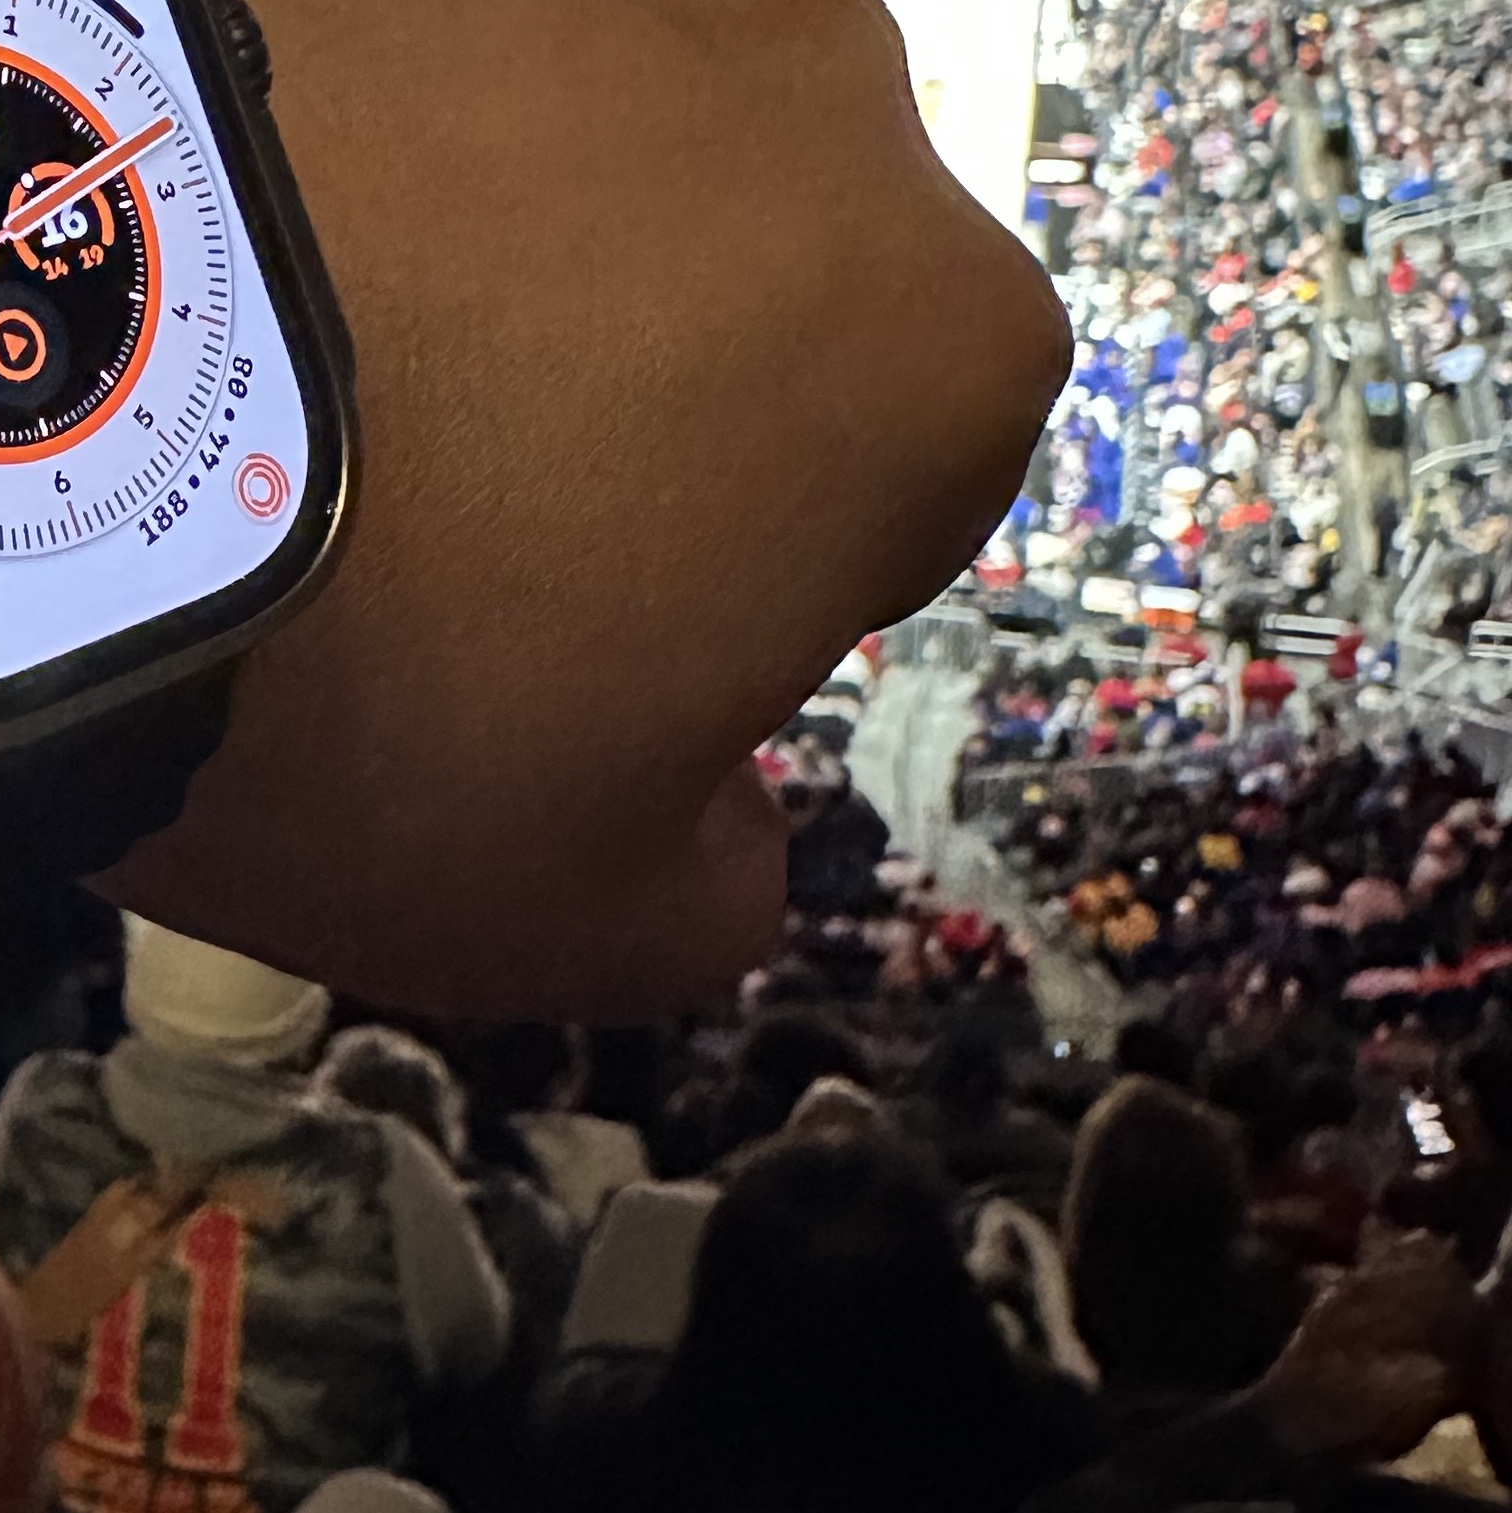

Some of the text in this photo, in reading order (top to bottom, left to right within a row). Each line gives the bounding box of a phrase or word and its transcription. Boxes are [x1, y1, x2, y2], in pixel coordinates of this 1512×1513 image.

[2, 15, 18, 38] 1
[94, 76, 114, 102] 2
[157, 180, 176, 202] 3
[41, 201, 89, 248] 16
[42, 256, 69, 281] 14
[172, 303, 192, 322] 4
[133, 404, 154, 430] 5
[54, 470, 71, 495] 6
